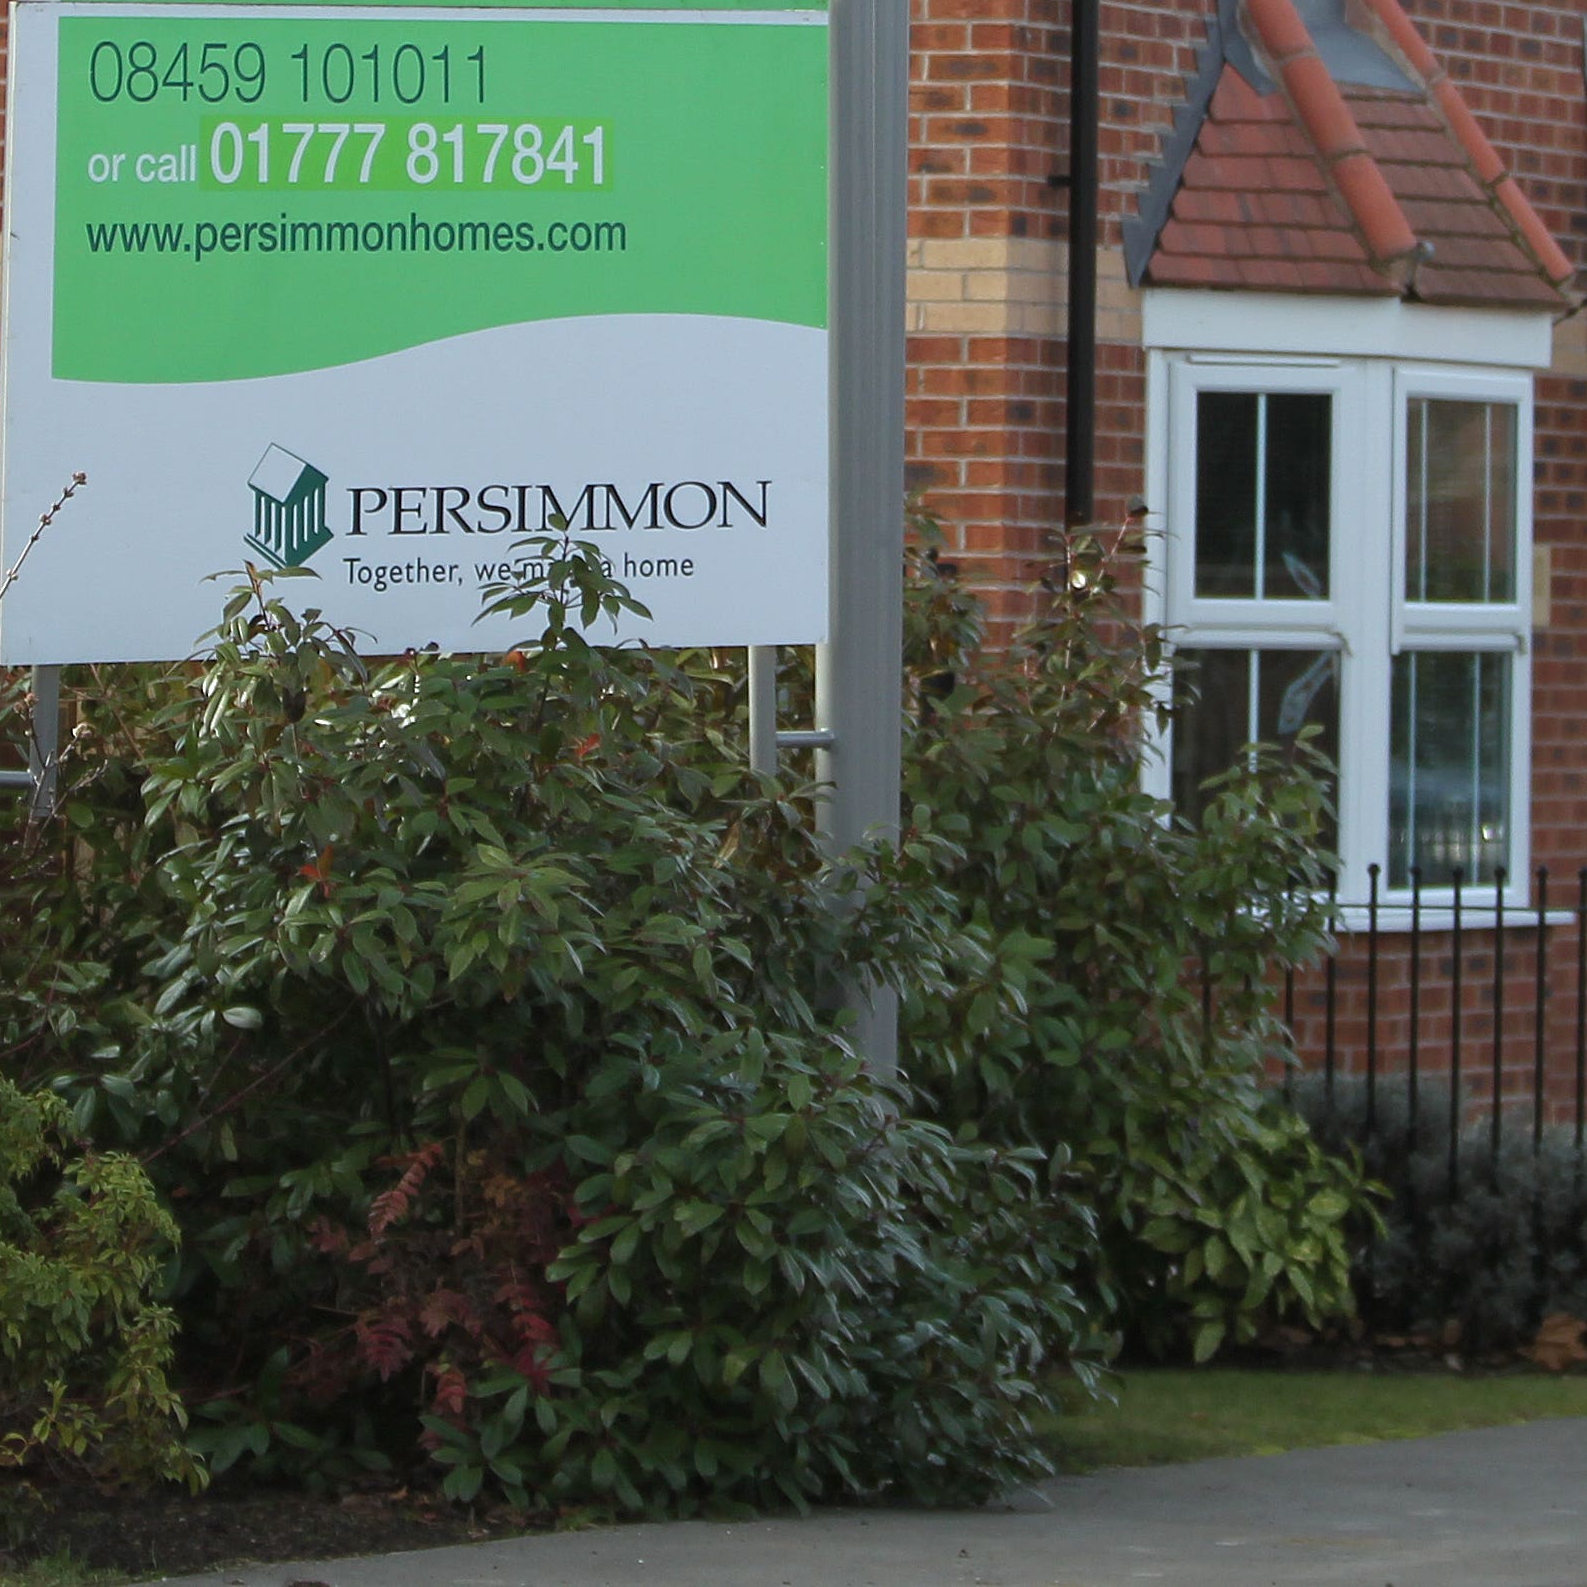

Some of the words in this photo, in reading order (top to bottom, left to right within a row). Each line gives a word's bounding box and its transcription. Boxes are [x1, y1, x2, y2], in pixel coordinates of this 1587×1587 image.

[89, 40, 267, 104] 08459
[289, 42, 486, 104] 101011
[87, 153, 126, 184] or
[134, 143, 197, 183] call
[210, 121, 387, 184] 01777
[405, 122, 605, 186] 817841
[85, 211, 627, 263] www.persimmonhomes.com
[344, 479, 773, 536] PERSIMMON
[342, 556, 464, 592] Together,
[474, 563, 512, 581] we
[623, 552, 695, 579] home
